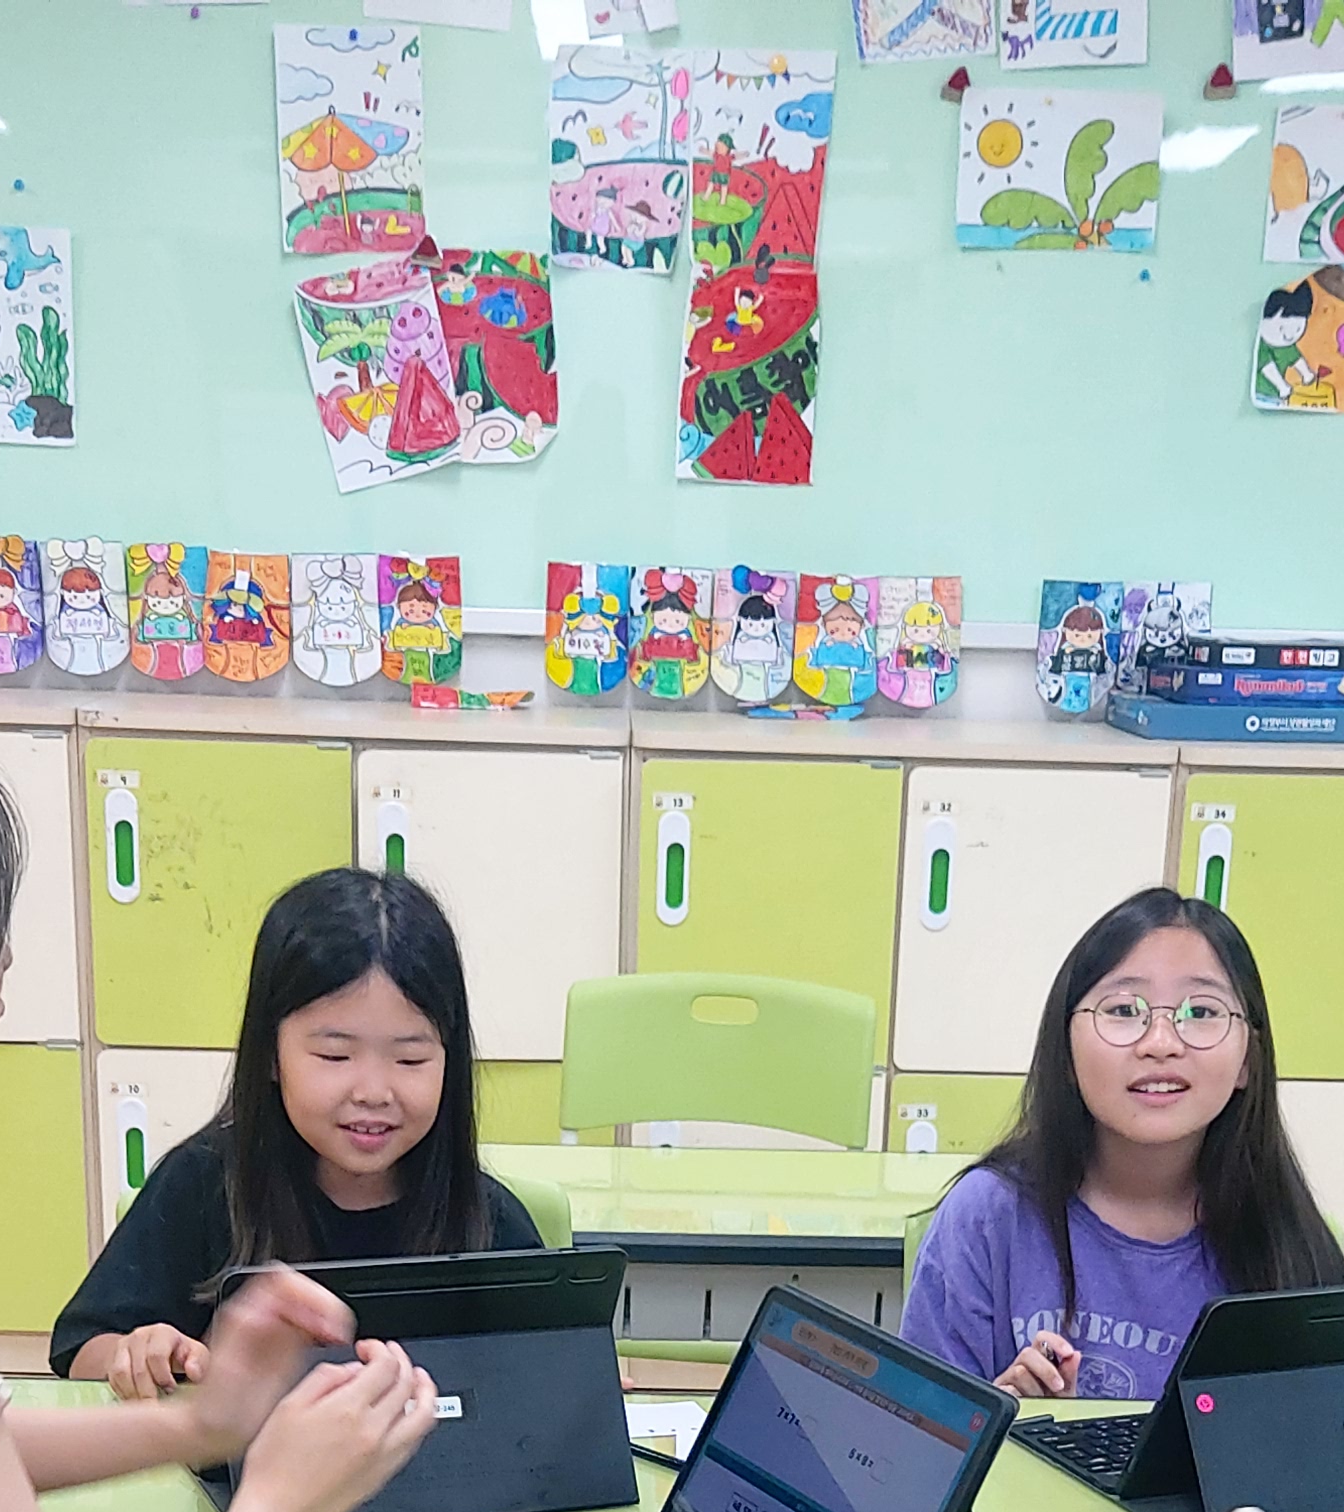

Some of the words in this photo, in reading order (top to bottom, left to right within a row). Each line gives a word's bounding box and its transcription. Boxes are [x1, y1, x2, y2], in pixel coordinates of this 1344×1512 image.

[392, 788, 401, 799] 11
[672, 797, 684, 808] 13
[940, 802, 952, 813] 32
[128, 1084, 140, 1094] 10
